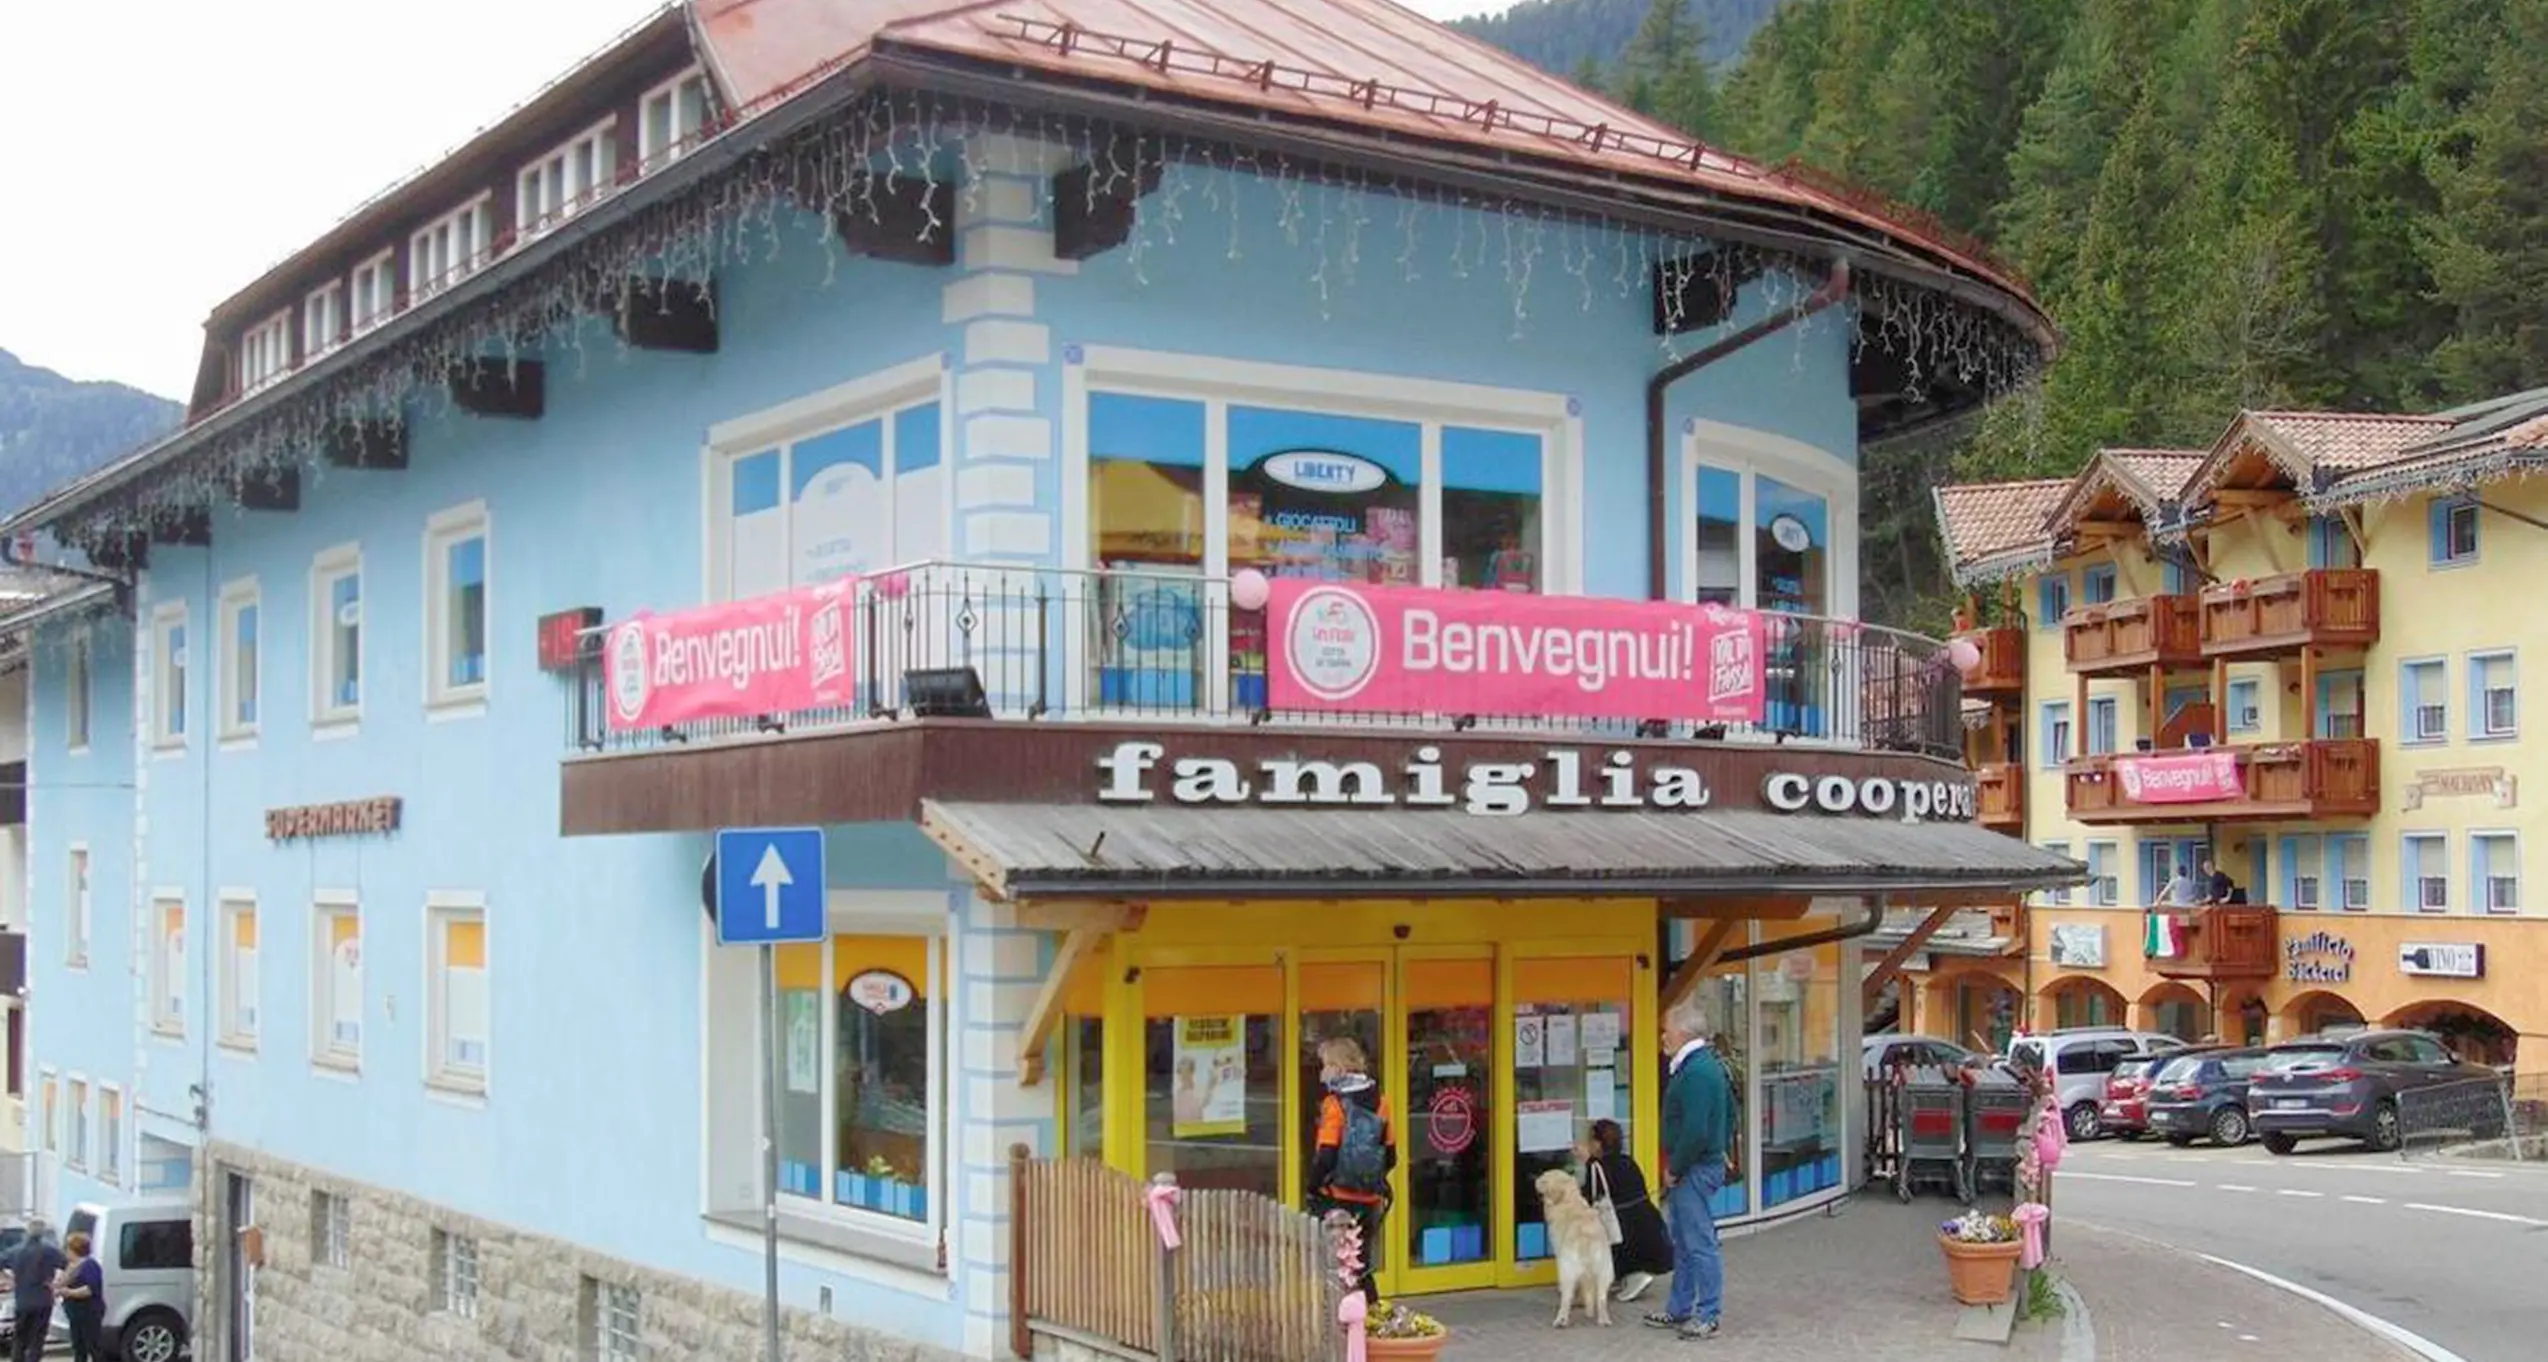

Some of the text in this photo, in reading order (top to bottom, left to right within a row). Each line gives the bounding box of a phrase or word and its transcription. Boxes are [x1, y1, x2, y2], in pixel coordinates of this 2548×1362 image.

[1294, 460, 1356, 484] LIBERTY
[1274, 512, 1357, 534] GIOCATTOLI
[653, 605, 801, 690] Benvegnui!
[1403, 609, 1693, 692] Benvegnui!
[1098, 742, 1711, 818] famiglia
[2141, 762, 2214, 792] Benvegnui!
[265, 797, 402, 840] SUPERMARKET
